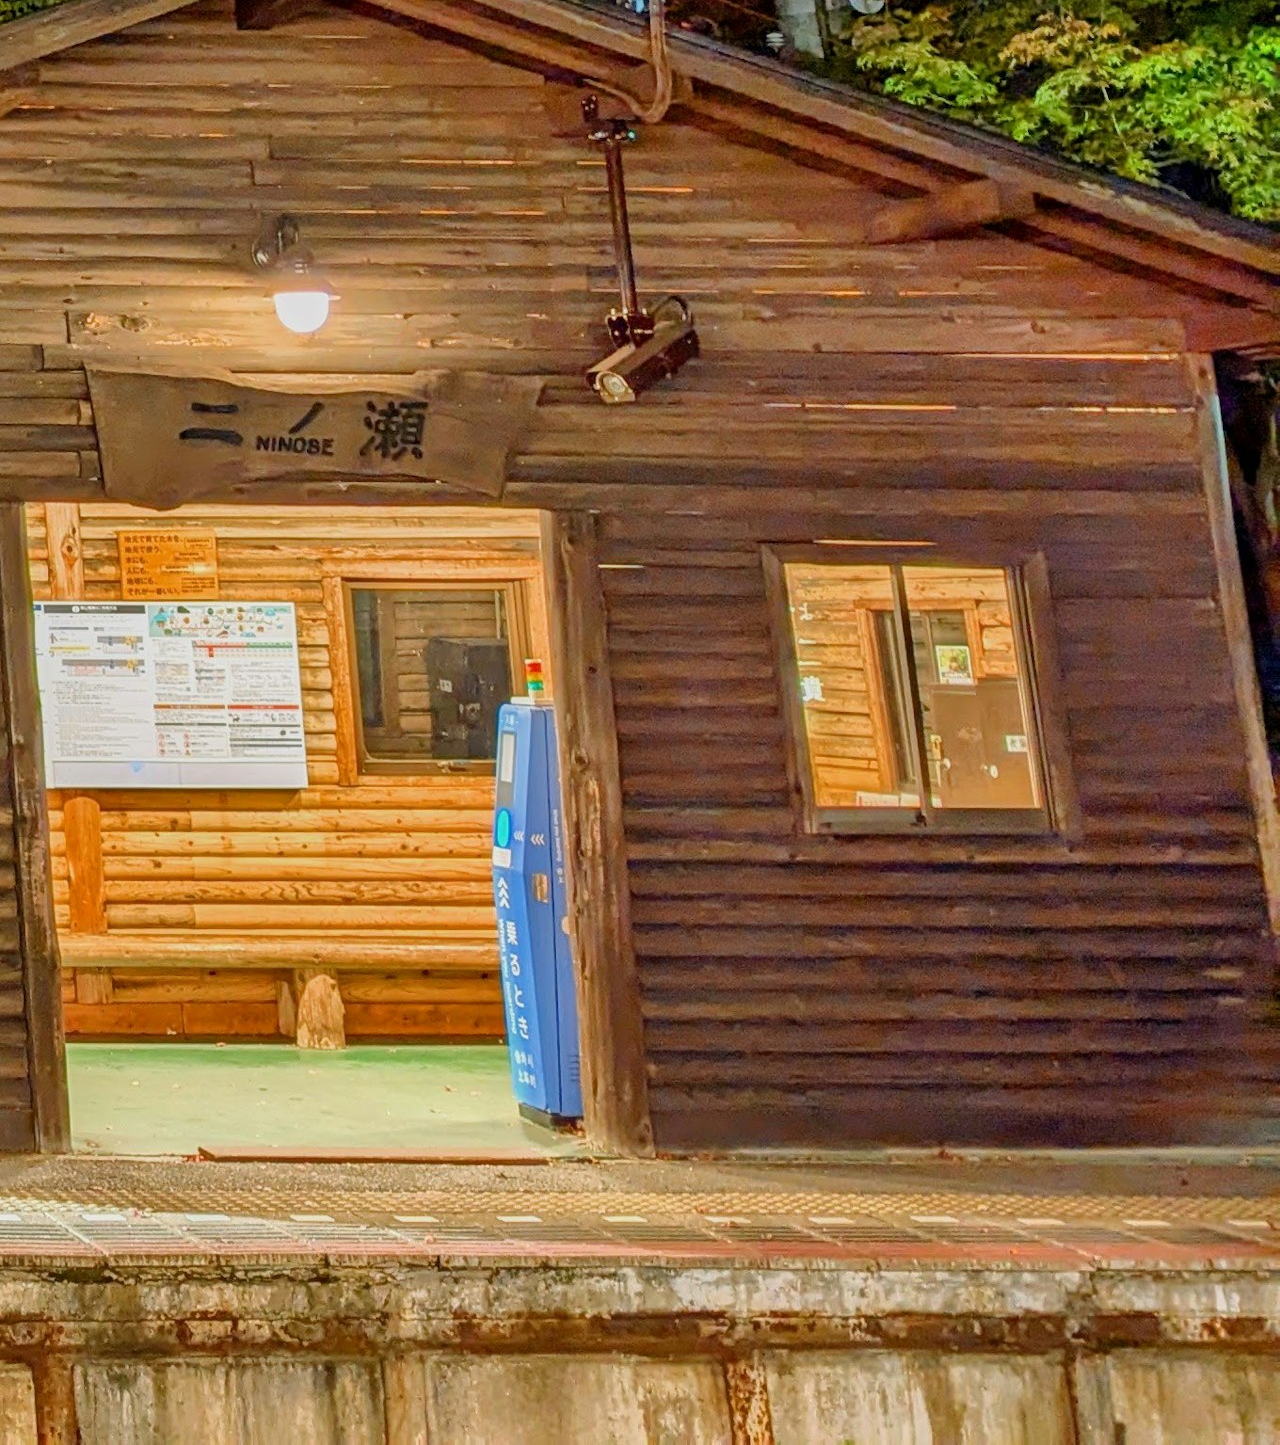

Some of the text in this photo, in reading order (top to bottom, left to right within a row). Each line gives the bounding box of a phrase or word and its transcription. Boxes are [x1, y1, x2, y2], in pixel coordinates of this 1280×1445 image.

[180, 401, 429, 461] 二ノ瀬
[255, 435, 335, 457] NINOSE
